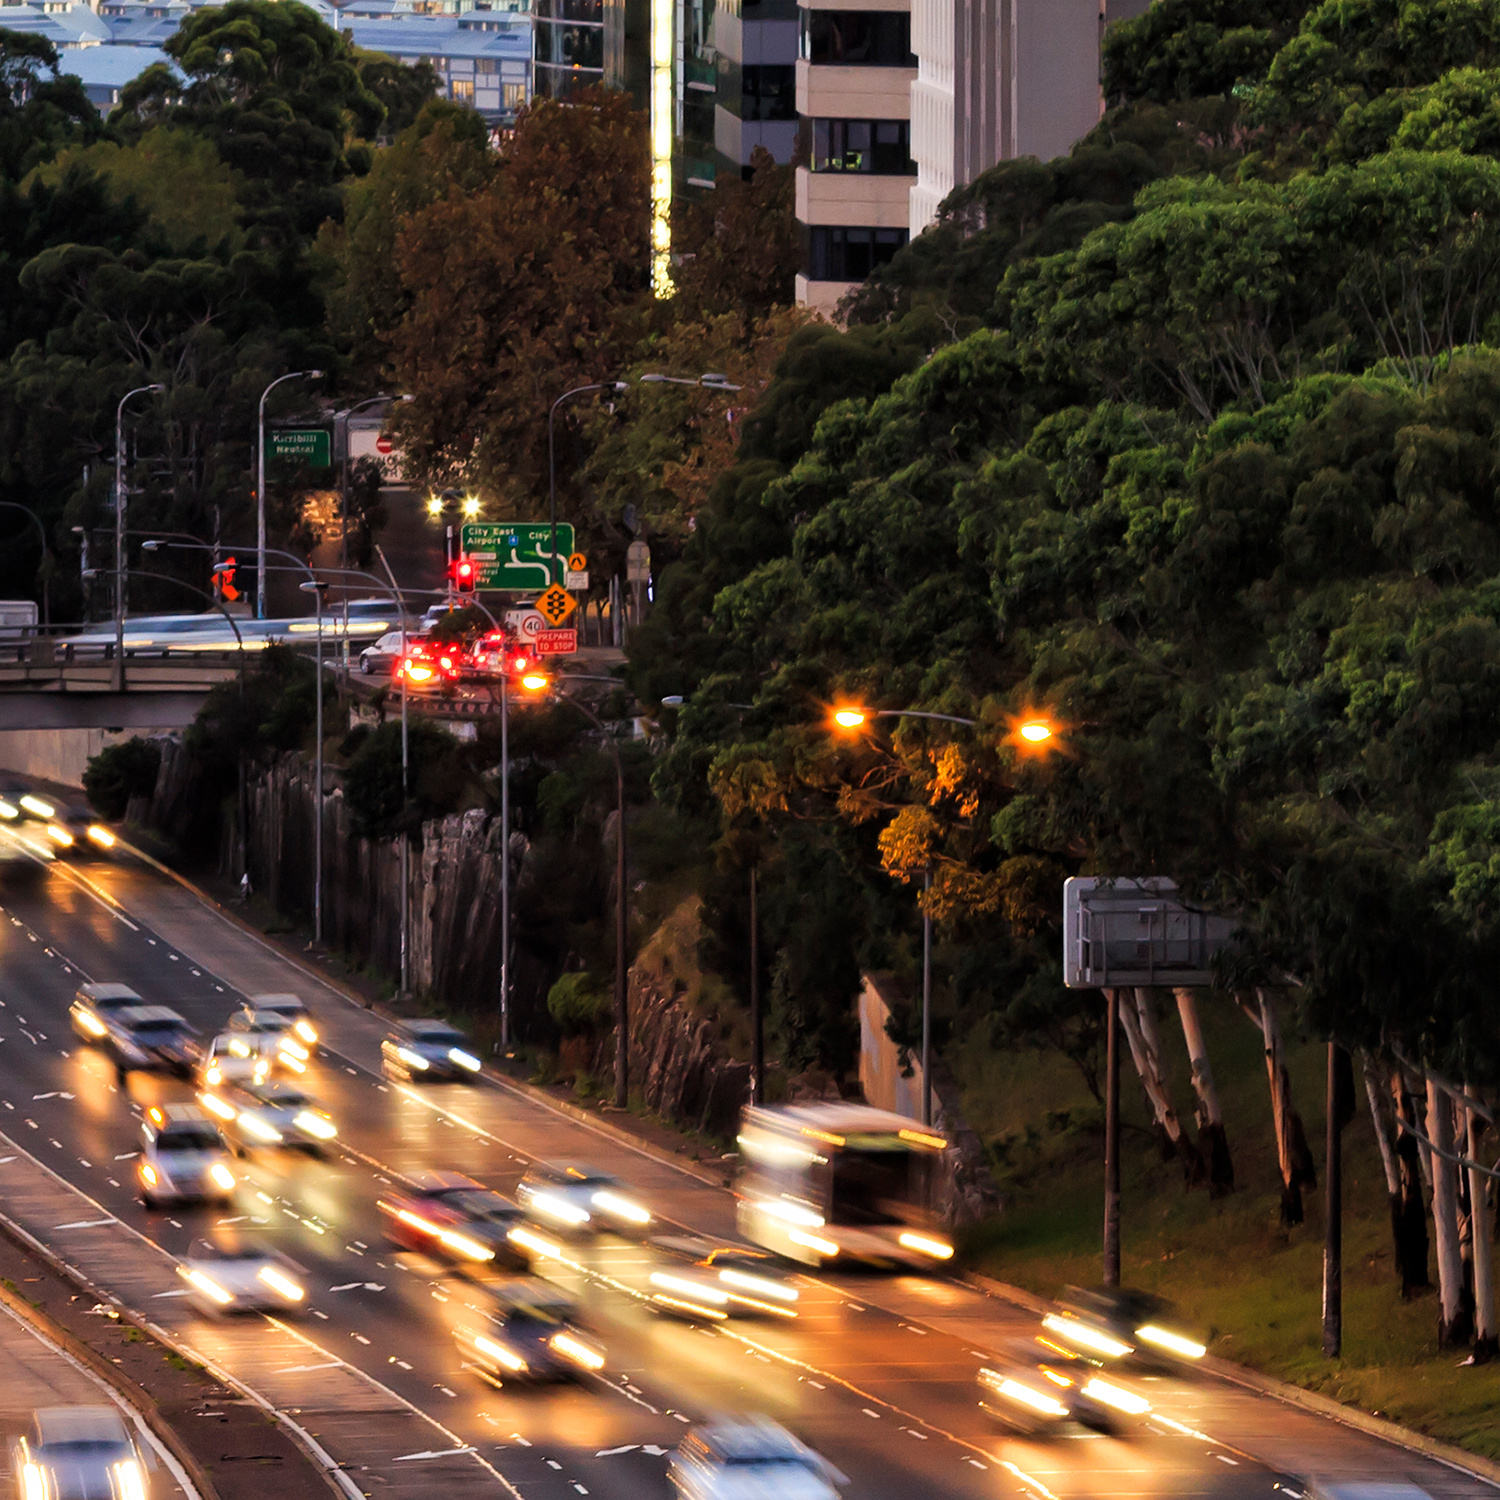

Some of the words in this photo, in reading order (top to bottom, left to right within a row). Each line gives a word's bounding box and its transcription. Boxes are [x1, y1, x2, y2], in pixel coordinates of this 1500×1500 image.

[468, 527, 488, 537] City
[493, 527, 514, 536] East
[528, 531, 549, 541] City
[467, 537, 501, 546] Airport
[527, 621, 541, 631] 40
[553, 641, 574, 651] STOP
